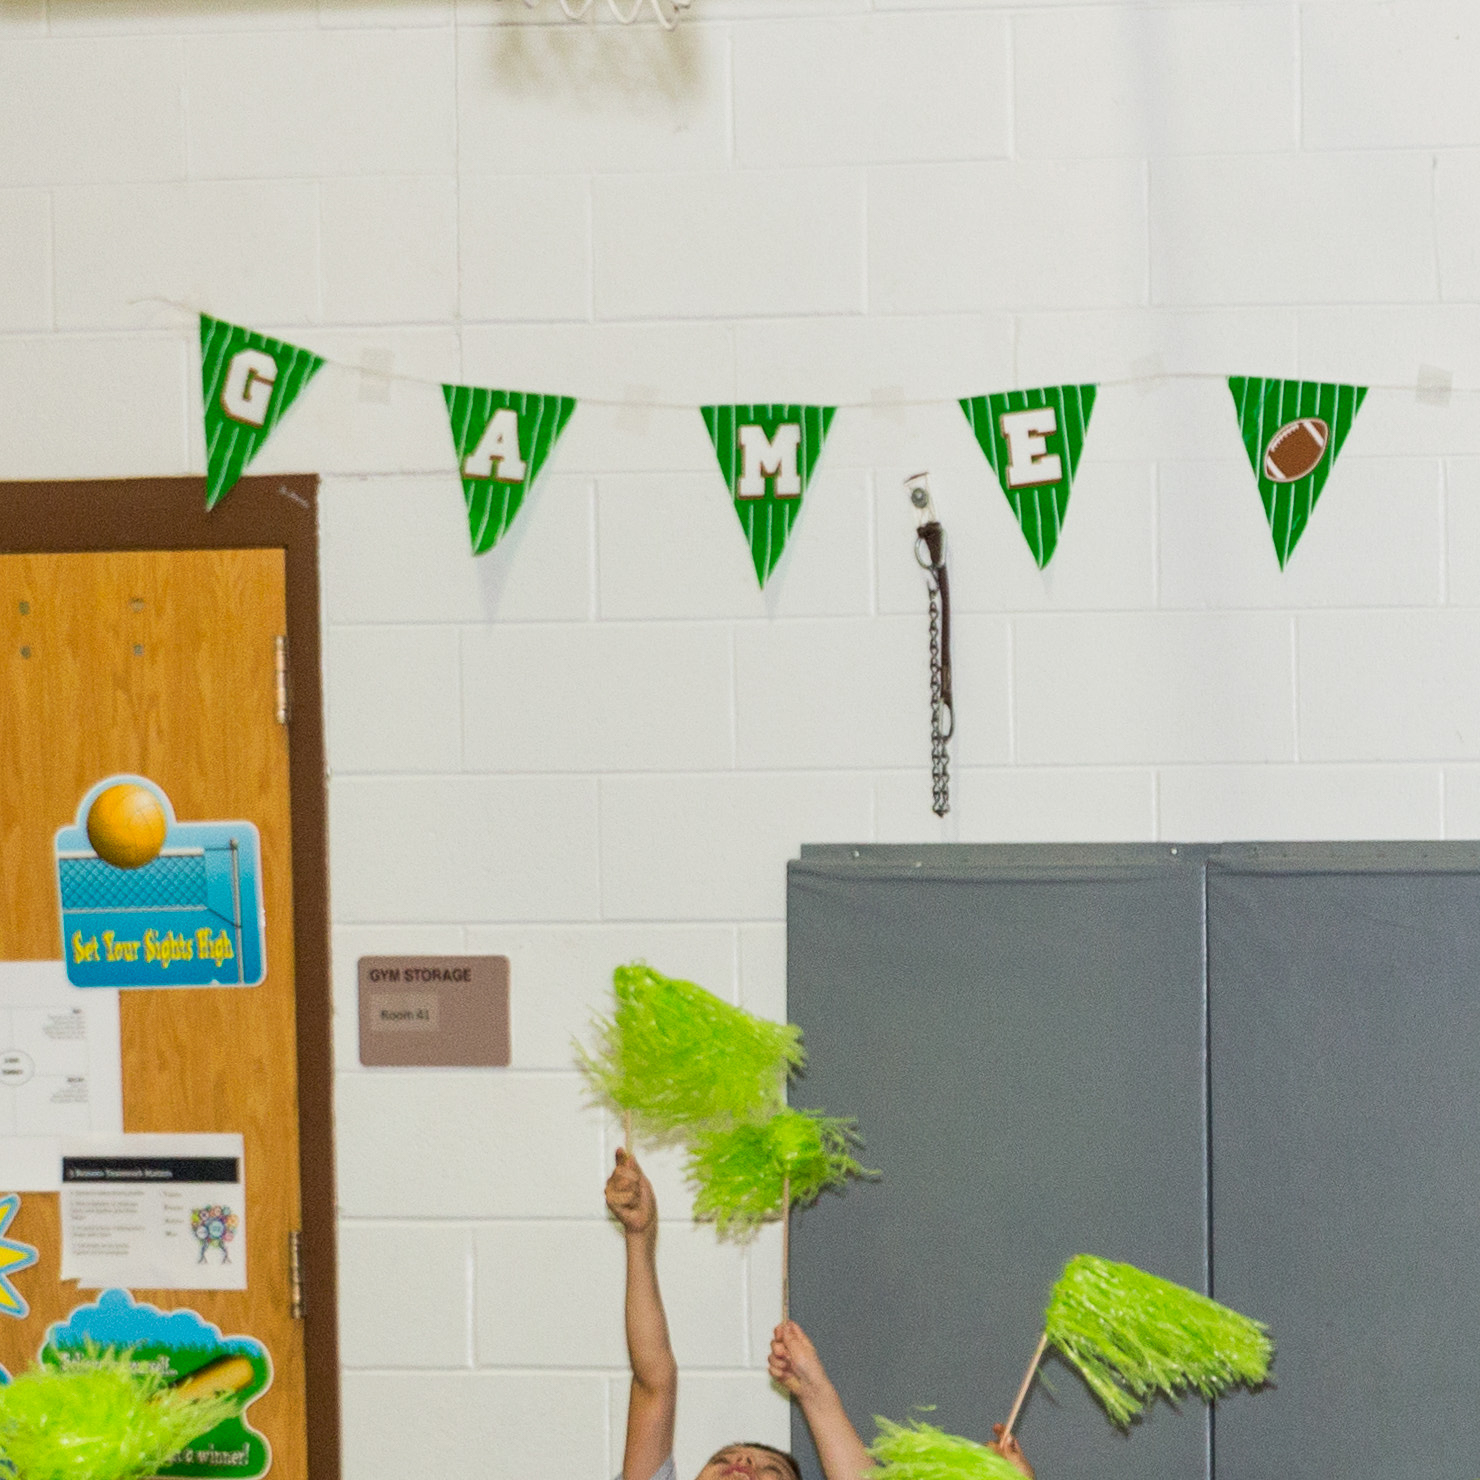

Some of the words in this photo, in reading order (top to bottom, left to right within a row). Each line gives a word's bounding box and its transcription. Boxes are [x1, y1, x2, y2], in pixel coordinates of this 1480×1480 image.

[72, 930, 101, 964] Set
[102, 930, 141, 962] Your
[143, 928, 193, 969] Sights
[195, 927, 235, 967] High
[369, 968, 400, 983] GYM
[404, 968, 472, 983] STORAGE
[197, 1442, 250, 1467] winner!
